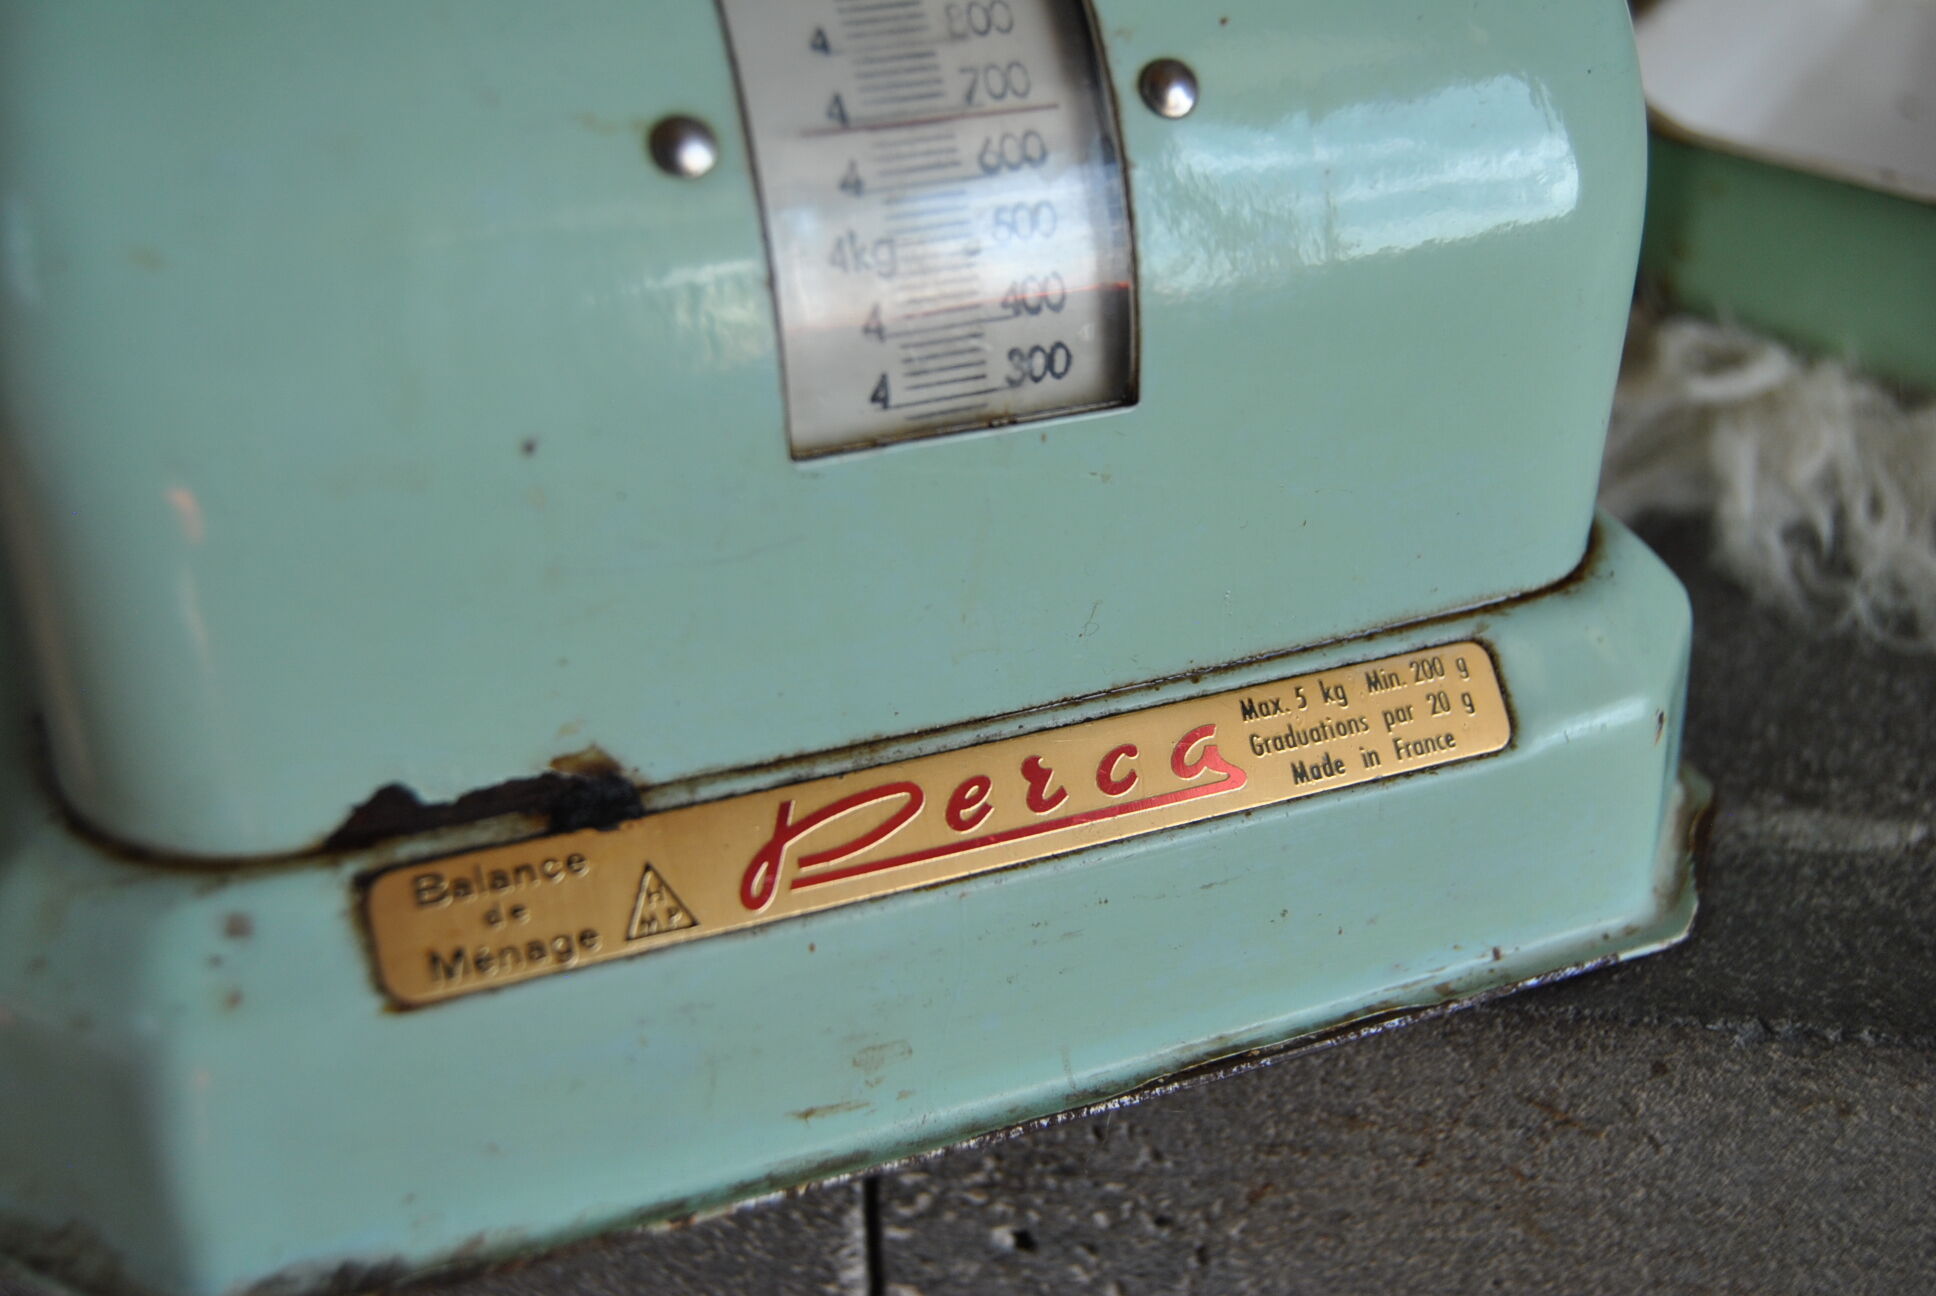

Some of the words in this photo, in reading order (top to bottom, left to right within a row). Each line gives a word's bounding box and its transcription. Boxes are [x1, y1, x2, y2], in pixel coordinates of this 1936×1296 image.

[810, 27, 832, 55] 4
[826, 92, 850, 126] 4
[958, 61, 1031, 105] 700
[840, 160, 864, 196] 4
[977, 129, 1048, 175] 600
[991, 200, 1058, 242] 500
[862, 304, 886, 342] 4
[1001, 271, 1067, 318] 400
[870, 373, 891, 410] 4
[1005, 341, 1072, 388] 300
[1239, 698, 1292, 723] Max.
[1296, 687, 1309, 711] 5
[1318, 680, 1349, 709] kg
[1366, 669, 1406, 694] Min.
[1409, 656, 1445, 685] 200
[1455, 657, 1471, 680] g
[1249, 714, 1370, 758] Graduations
[1382, 703, 1415, 732] par
[1426, 691, 1452, 717] 20
[1461, 692, 1476, 716] g
[1290, 752, 1347, 786] Made
[1360, 746, 1382, 770] in
[1392, 730, 1457, 762] France
[414, 852, 590, 906] Balance
[483, 900, 530, 929] de
